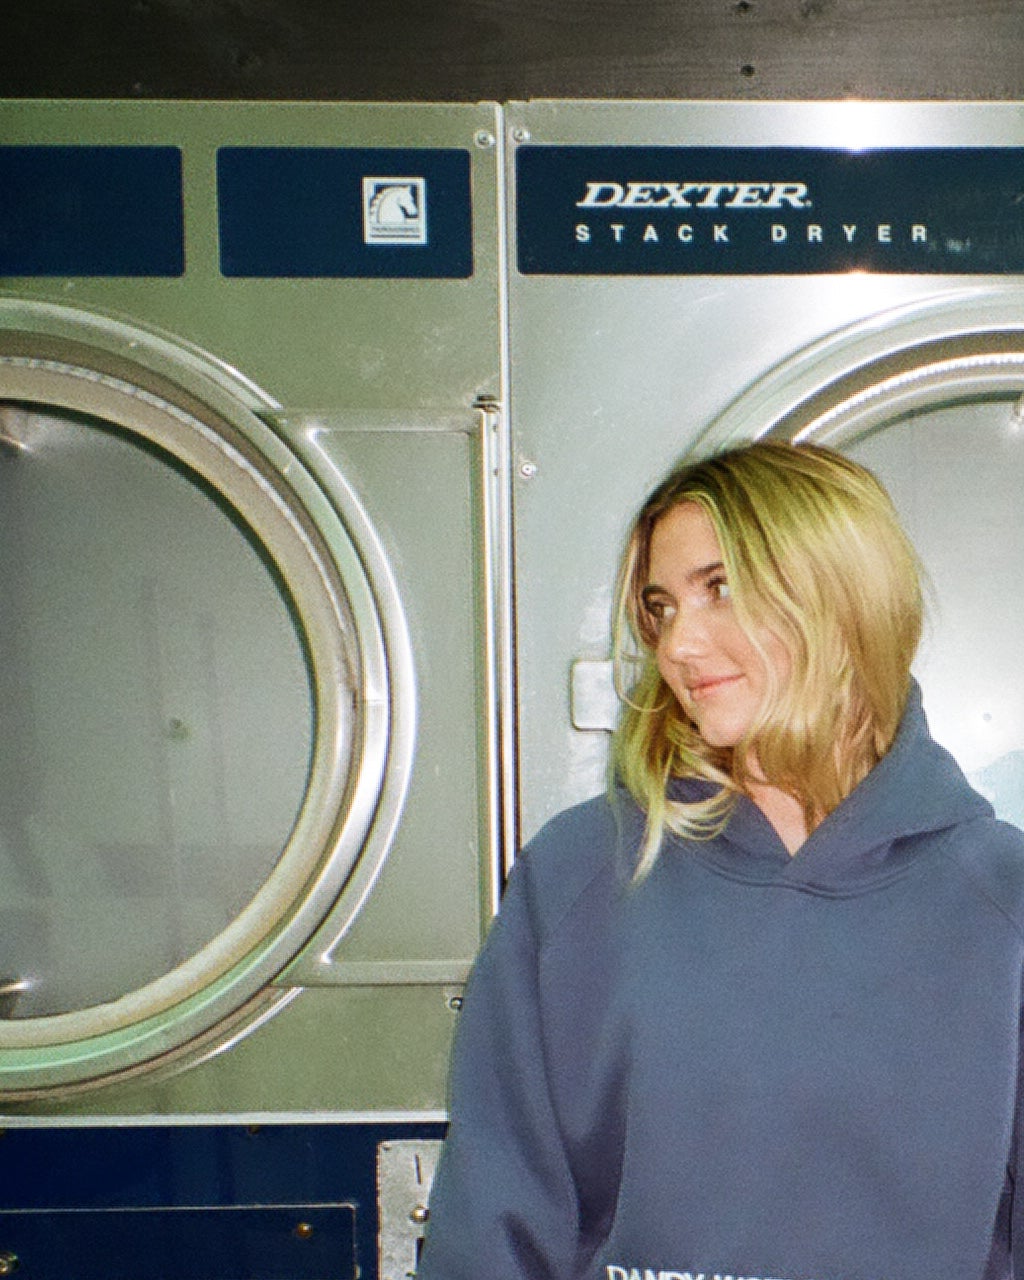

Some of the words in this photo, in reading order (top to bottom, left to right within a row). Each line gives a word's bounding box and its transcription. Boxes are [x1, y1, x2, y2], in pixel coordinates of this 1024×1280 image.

[576, 182, 806, 209] DEXTER
[576, 225, 729, 242] STACK
[772, 224, 928, 242] DRYER
